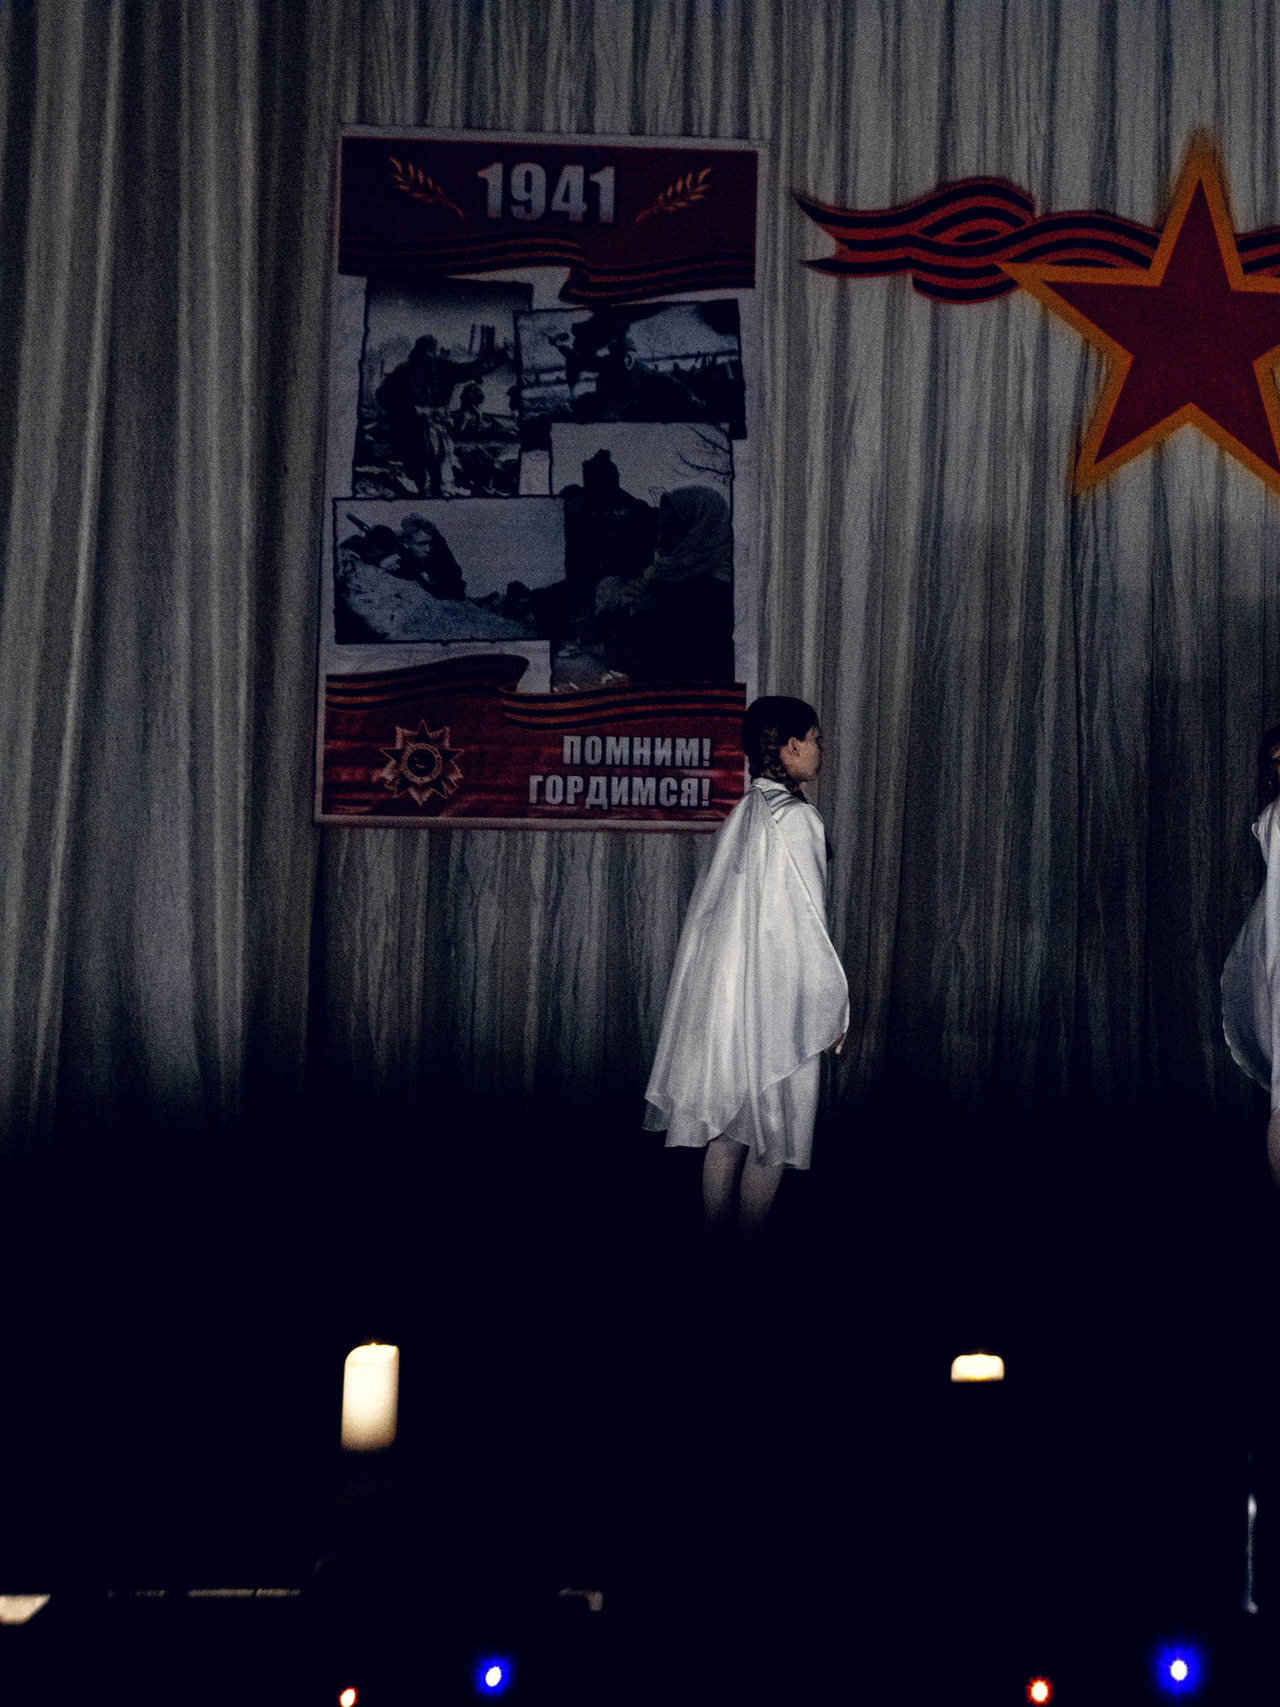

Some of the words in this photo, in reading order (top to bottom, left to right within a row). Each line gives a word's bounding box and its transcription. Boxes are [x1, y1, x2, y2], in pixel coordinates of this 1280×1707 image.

[477, 161, 616, 224] 1941
[562, 735, 712, 768] ПОМНИМ!
[528, 775, 711, 810] ГОРДИМСЯ!
